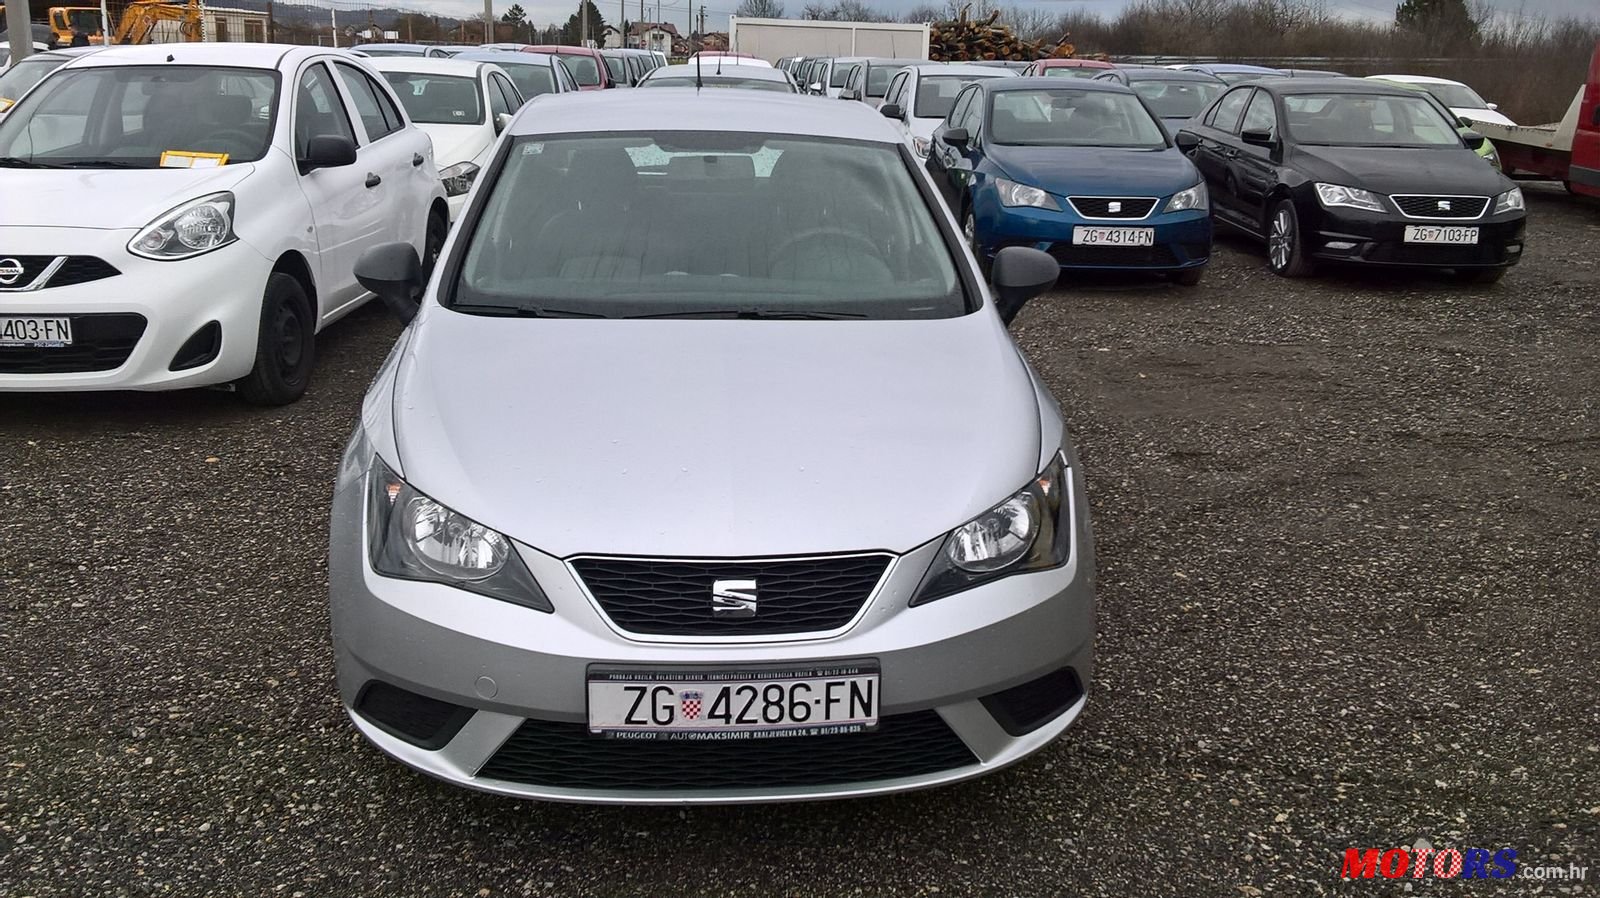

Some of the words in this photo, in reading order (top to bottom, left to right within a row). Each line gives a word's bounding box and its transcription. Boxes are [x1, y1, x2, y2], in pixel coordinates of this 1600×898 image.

[1083, 229, 1097, 243] ZG
[1106, 230, 1152, 244] 4314-FN
[1413, 228, 1427, 241] ZG
[1434, 229, 1477, 242] 7103-FP
[623, 685, 675, 726] ZG
[707, 679, 873, 725] 4286-FN
[616, 731, 657, 739] PEUGEOT
